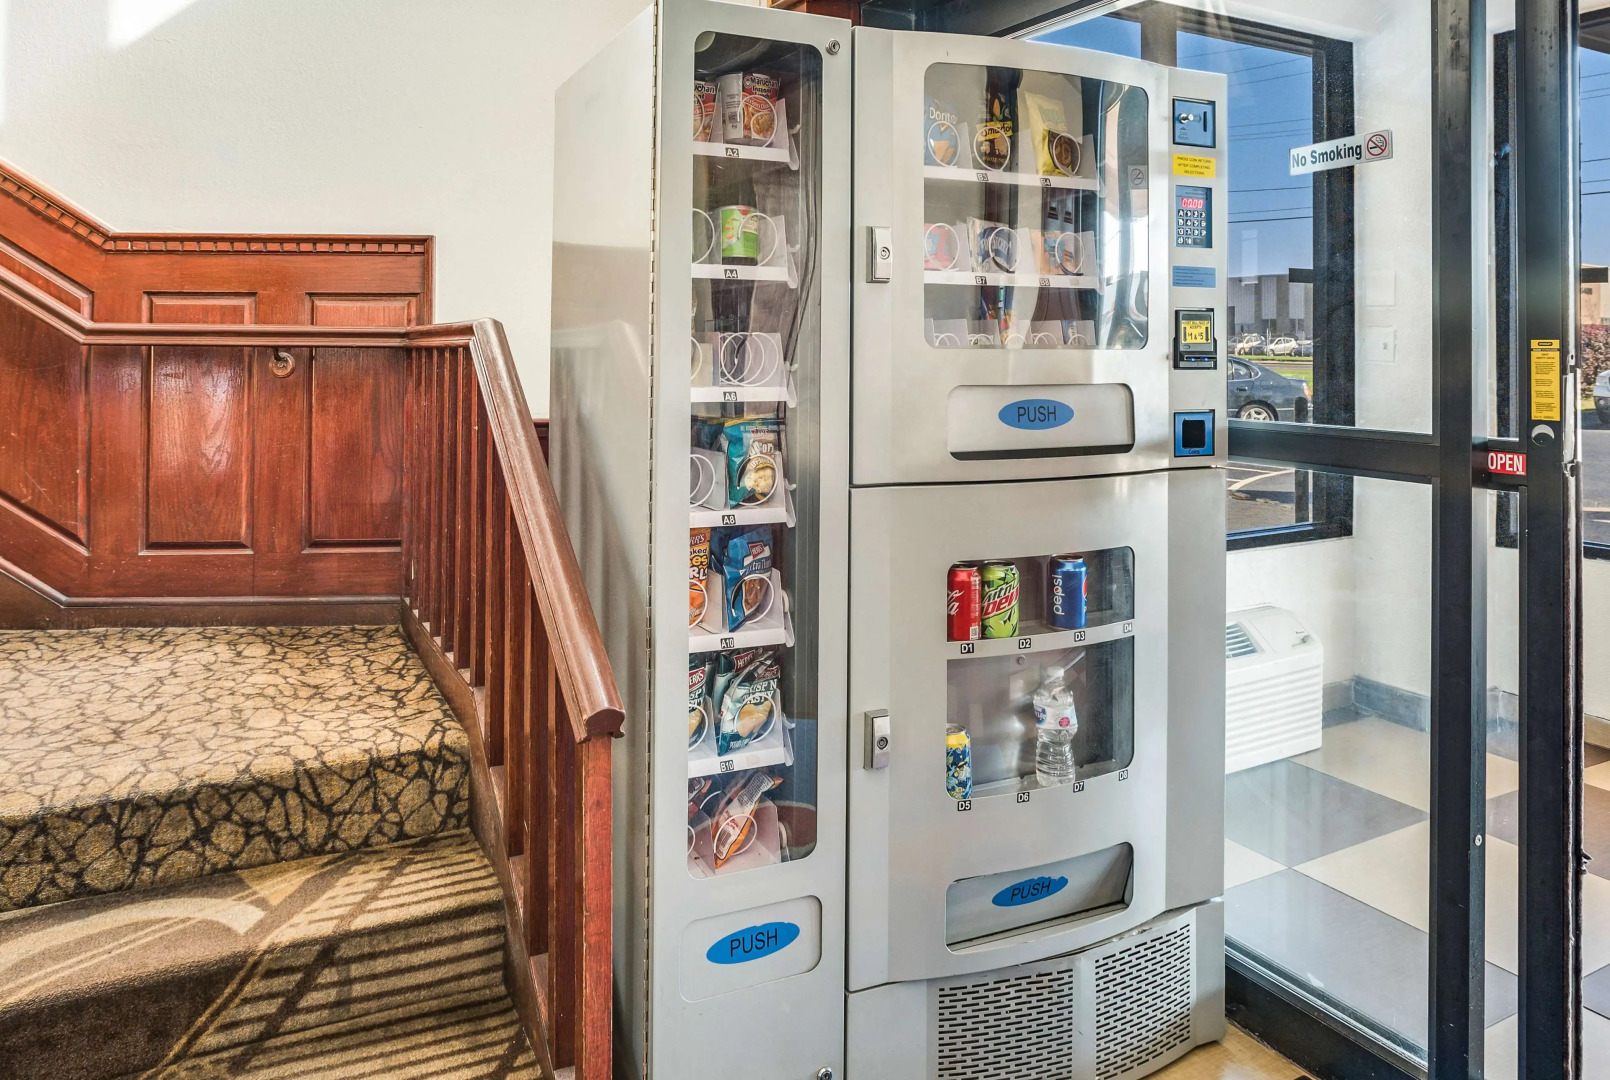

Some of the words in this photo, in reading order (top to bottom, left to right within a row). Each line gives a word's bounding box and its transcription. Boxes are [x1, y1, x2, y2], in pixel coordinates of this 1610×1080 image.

[726, 148, 739, 157] A2
[1291, 153, 1307, 168] No
[1310, 144, 1362, 165] Smoking
[977, 173, 988, 181] B3
[725, 270, 738, 279] A4
[975, 276, 987, 284] B7
[724, 392, 737, 401] A6
[1017, 405, 1057, 423] PUSH
[1488, 453, 1523, 472] OPEN
[723, 515, 735, 525] A8
[1052, 574, 1065, 615] pepsi
[1124, 624, 1132, 633] D4
[1075, 632, 1085, 641] D3
[721, 639, 735, 649] A10
[961, 644, 974, 654] D1
[1019, 639, 1030, 649] D2
[720, 761, 734, 772] B10
[1119, 771, 1128, 780] D8
[1074, 782, 1084, 792] D7
[1017, 792, 1029, 802] D6
[958, 801, 971, 811] D5
[1010, 881, 1051, 902] PUSH
[729, 928, 778, 957] PUSH
